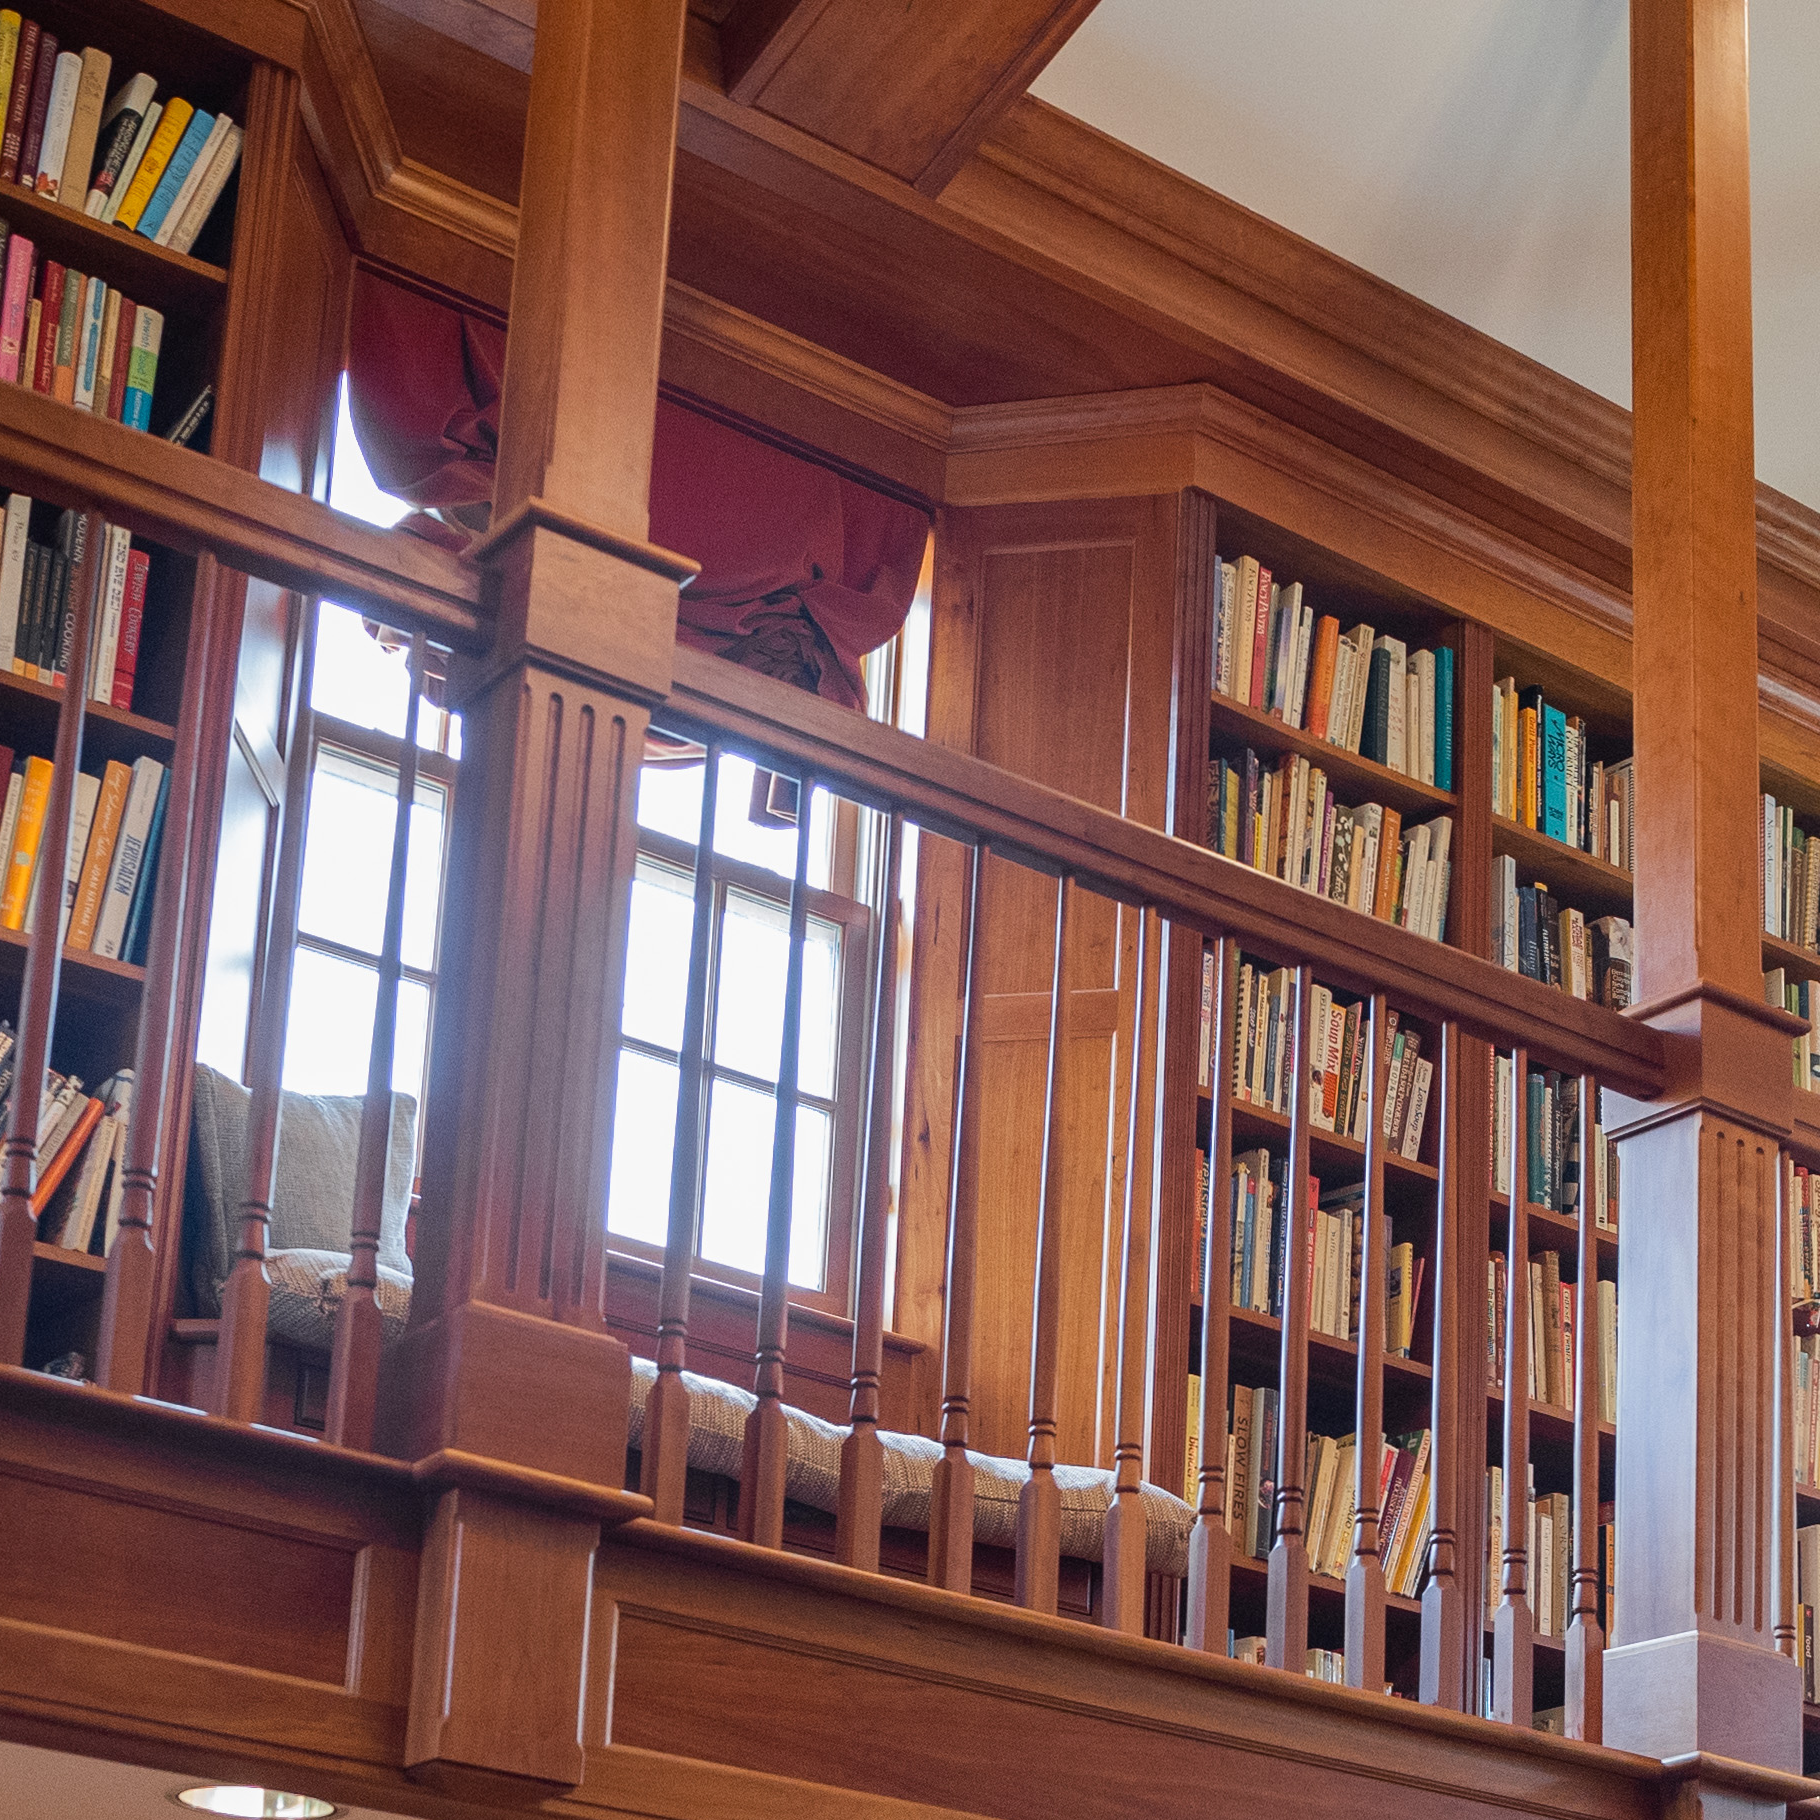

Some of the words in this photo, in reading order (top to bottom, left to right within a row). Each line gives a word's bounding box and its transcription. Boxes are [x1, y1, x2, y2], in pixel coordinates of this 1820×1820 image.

[140, 311, 155, 348] Jewish
[132, 562, 150, 600] JEWISH
[123, 606, 145, 656] COOKERY
[113, 834, 142, 897] JERUSALEM
[1323, 1009, 1345, 1044] Soup
[1324, 1046, 1341, 1072] Mix
[1231, 1414, 1250, 1456] SLOW
[1230, 1461, 1248, 1521] FIRES
